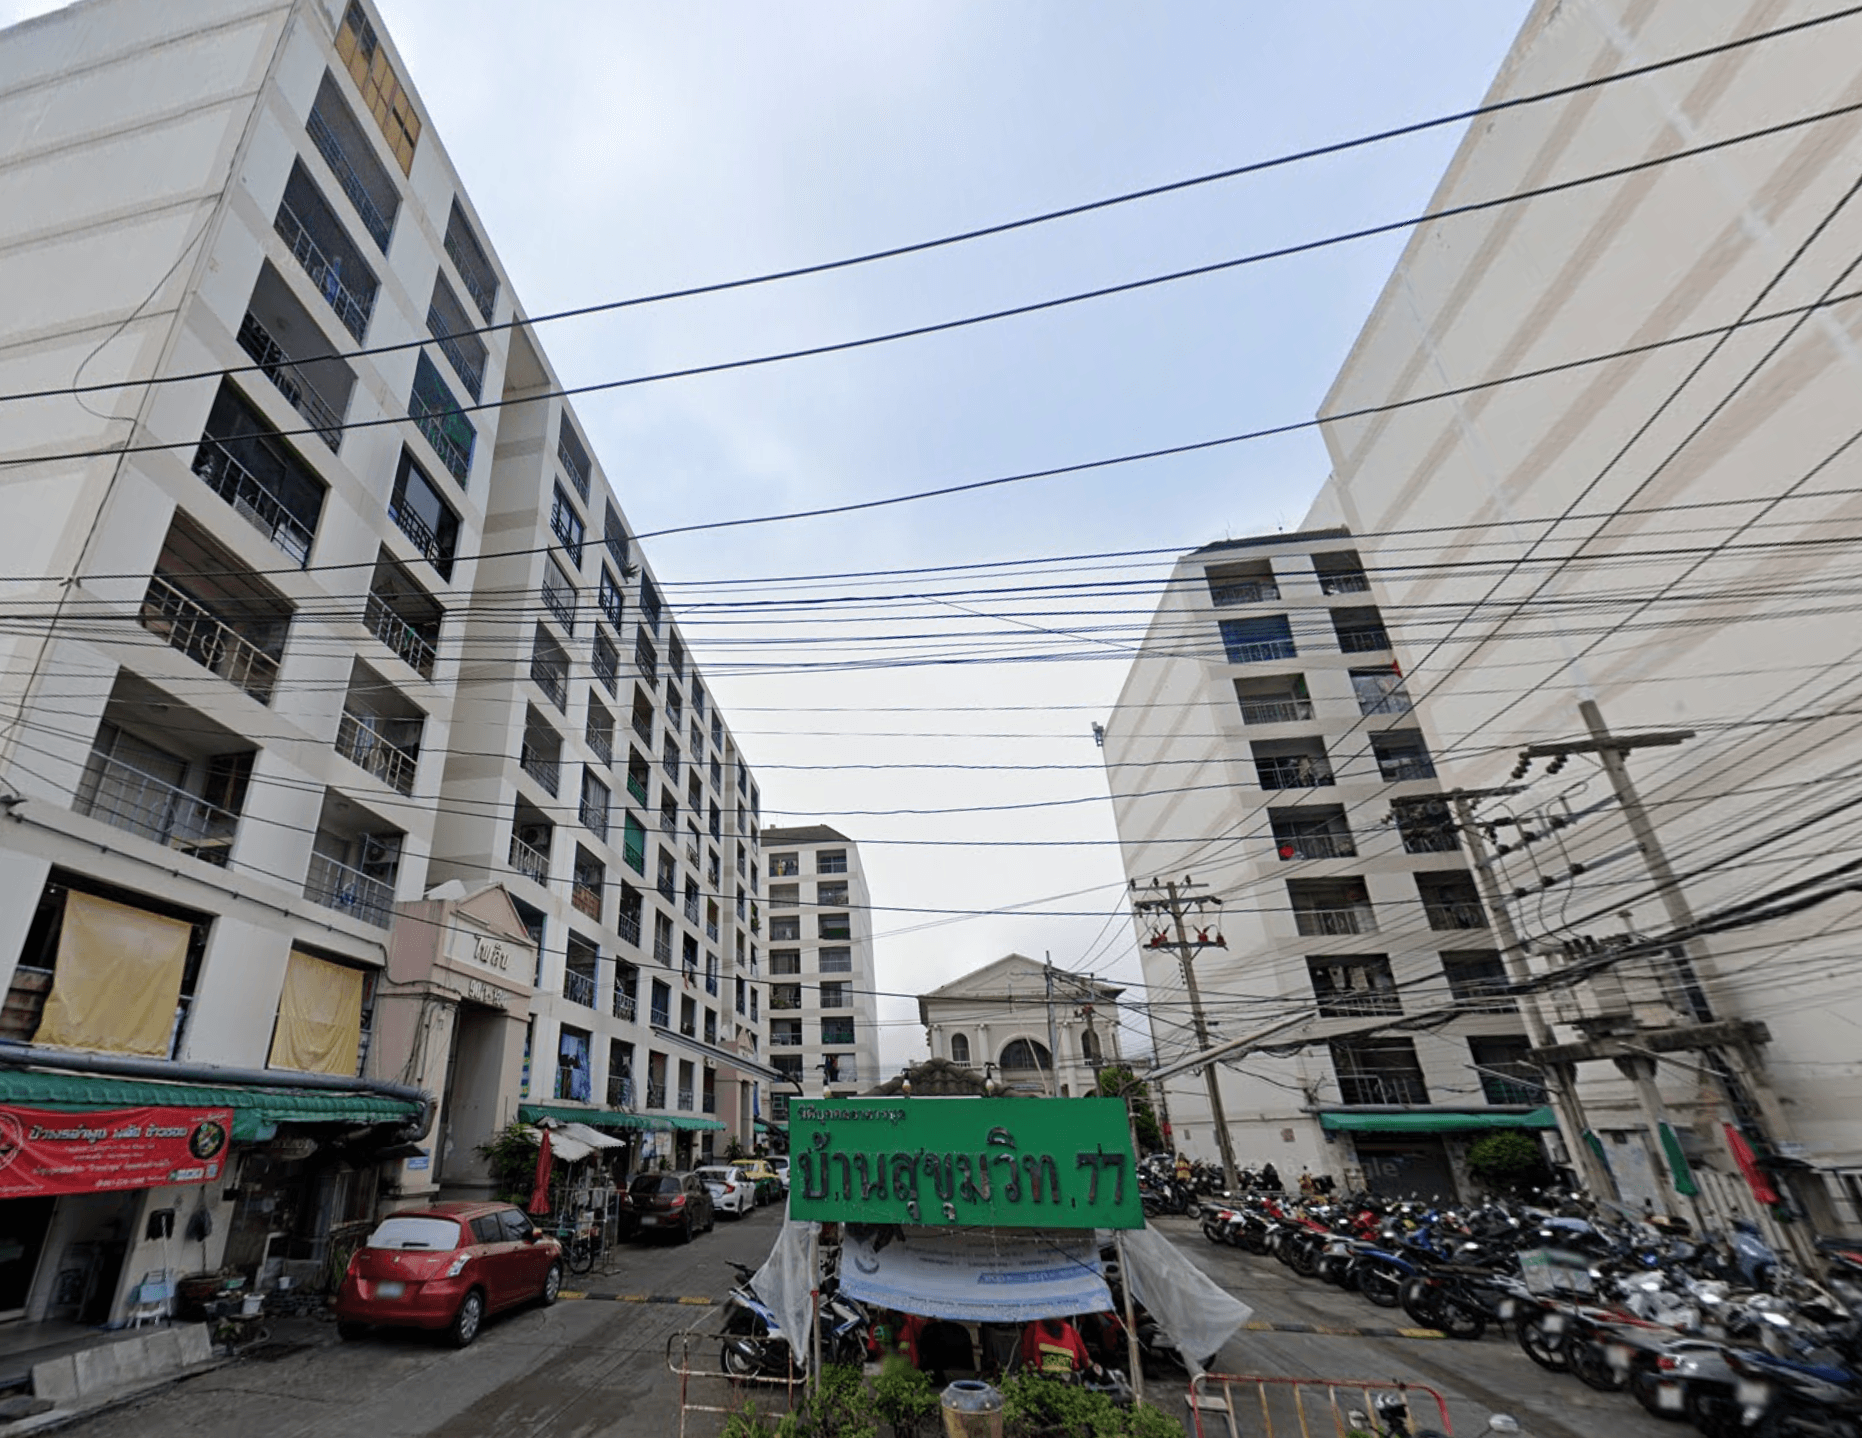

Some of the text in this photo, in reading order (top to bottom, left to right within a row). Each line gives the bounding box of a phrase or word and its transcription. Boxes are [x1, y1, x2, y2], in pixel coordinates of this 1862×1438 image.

[797, 1126, 1127, 1222] บ้านสุขุมวิท 77
